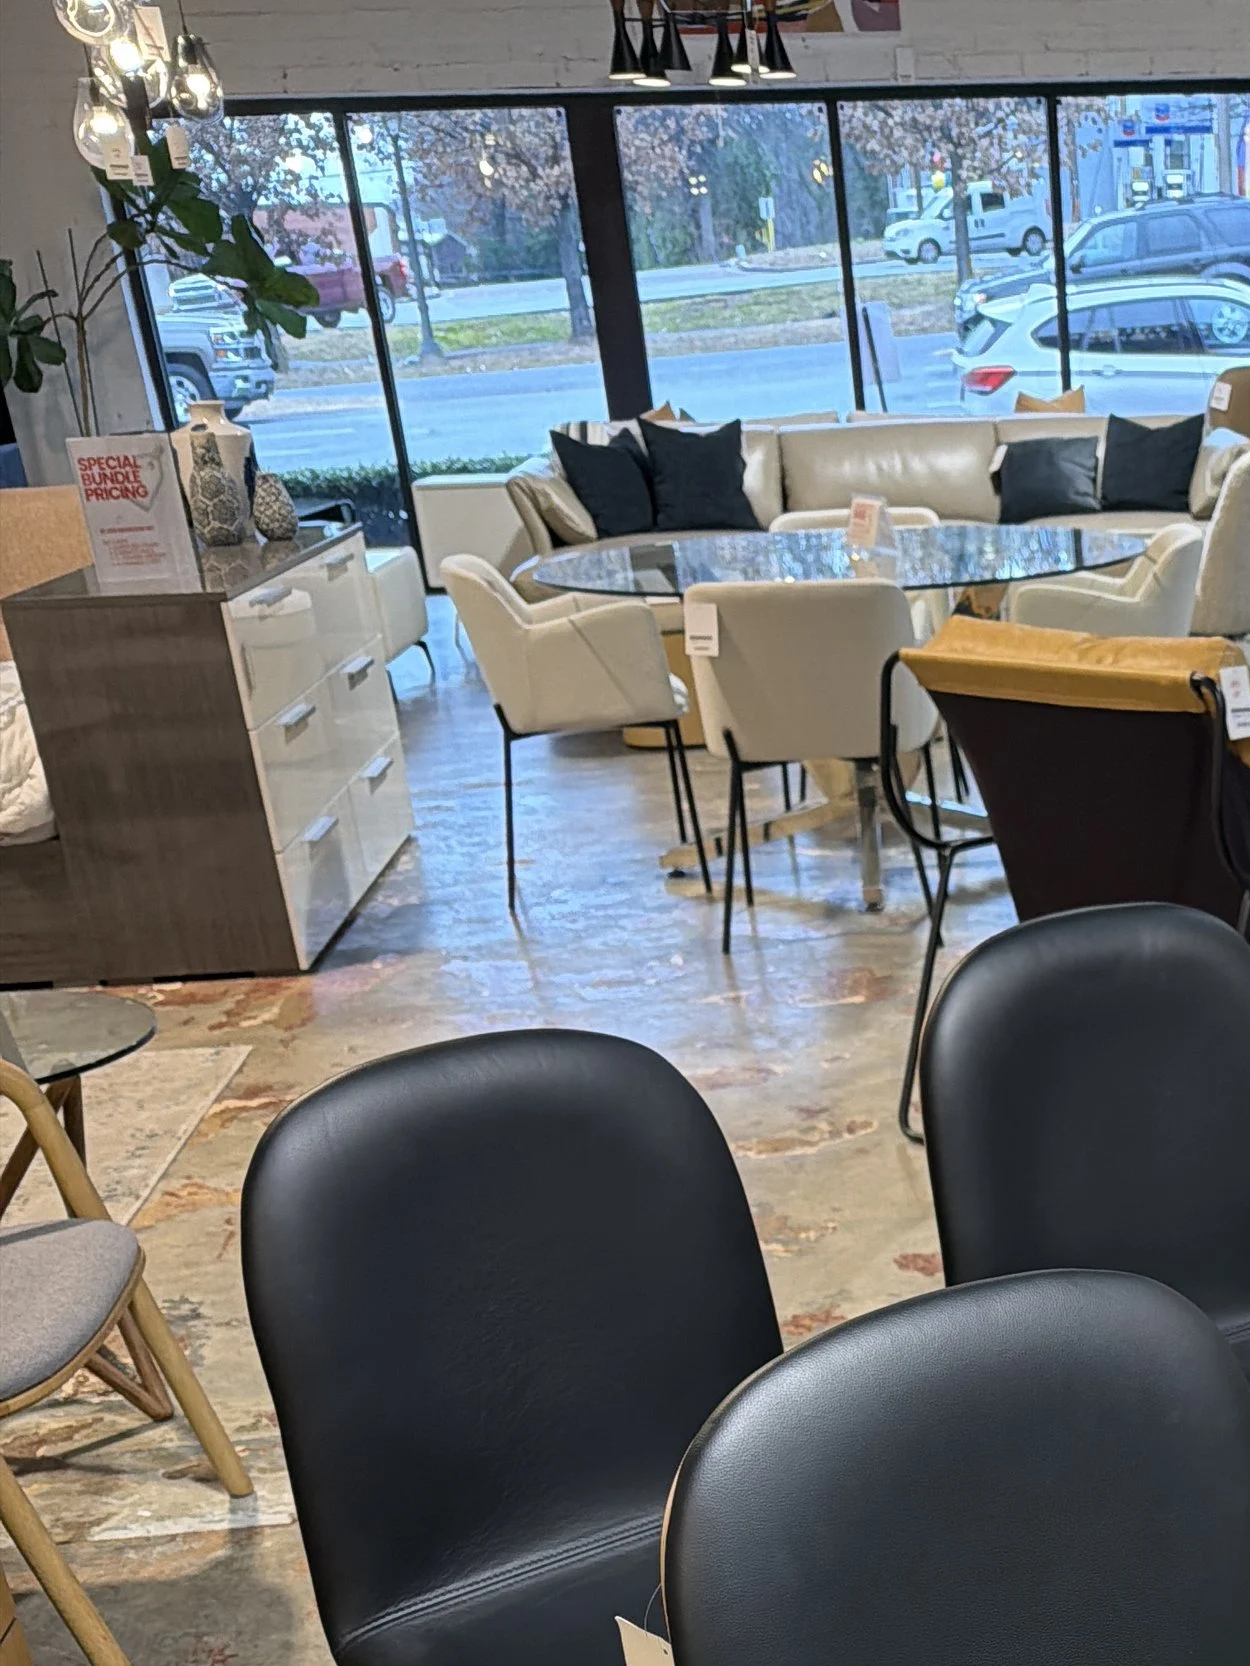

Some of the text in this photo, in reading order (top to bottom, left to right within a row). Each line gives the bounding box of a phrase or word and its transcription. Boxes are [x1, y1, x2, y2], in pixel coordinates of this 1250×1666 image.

[78, 455, 141, 471] SPECIAL
[81, 470, 142, 486] BUNDLE
[84, 484, 148, 502] PRICING
